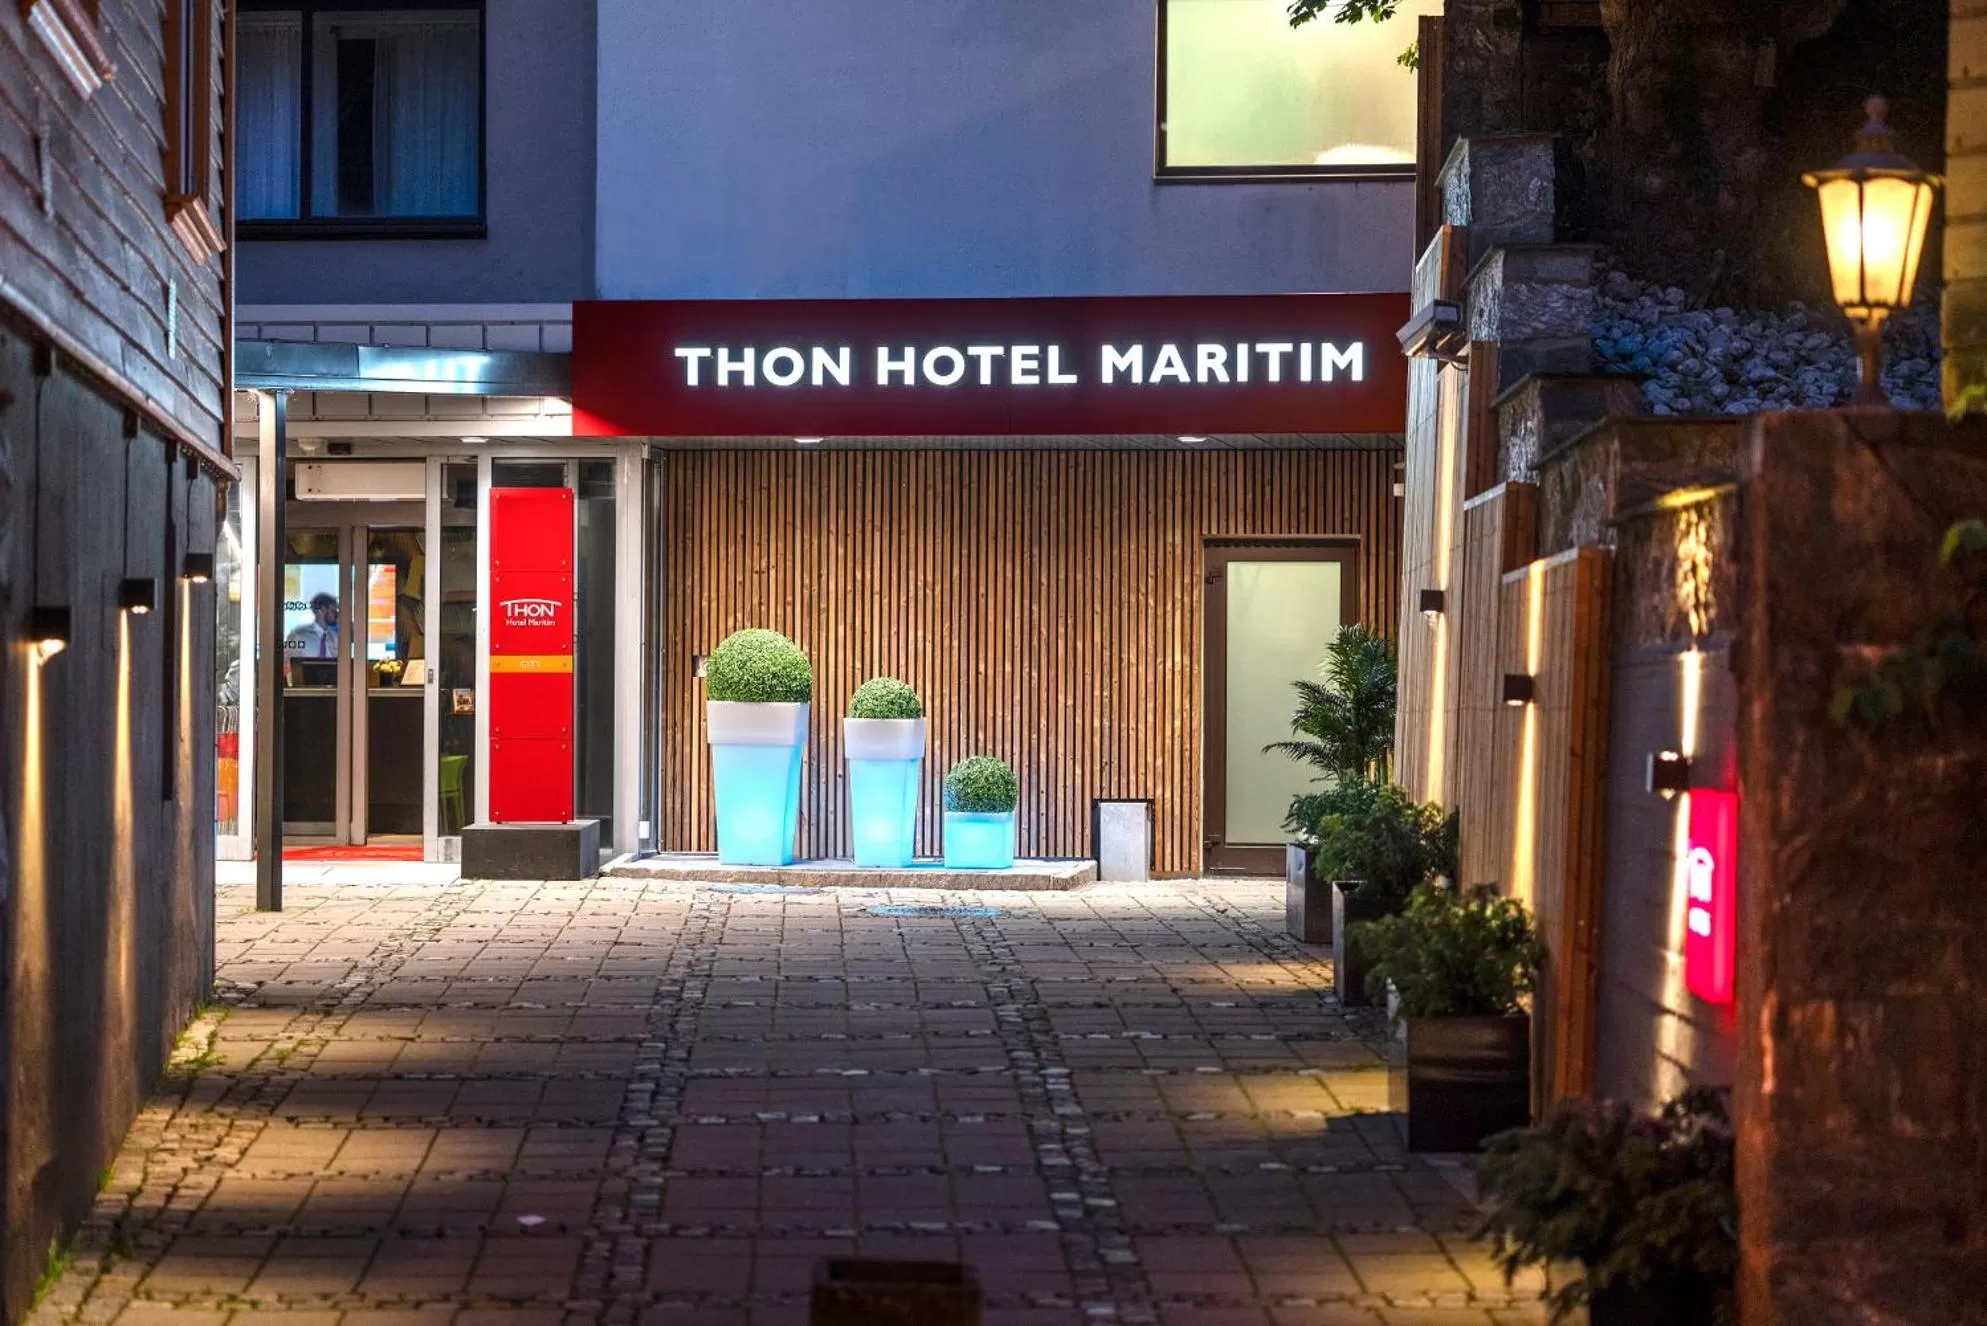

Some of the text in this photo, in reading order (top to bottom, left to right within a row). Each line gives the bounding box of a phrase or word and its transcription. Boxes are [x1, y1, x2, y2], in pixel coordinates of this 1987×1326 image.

[674, 341, 1364, 386] THON HOTEL MARITIM
[499, 598, 562, 617] THON
[506, 618, 526, 626] Hotel
